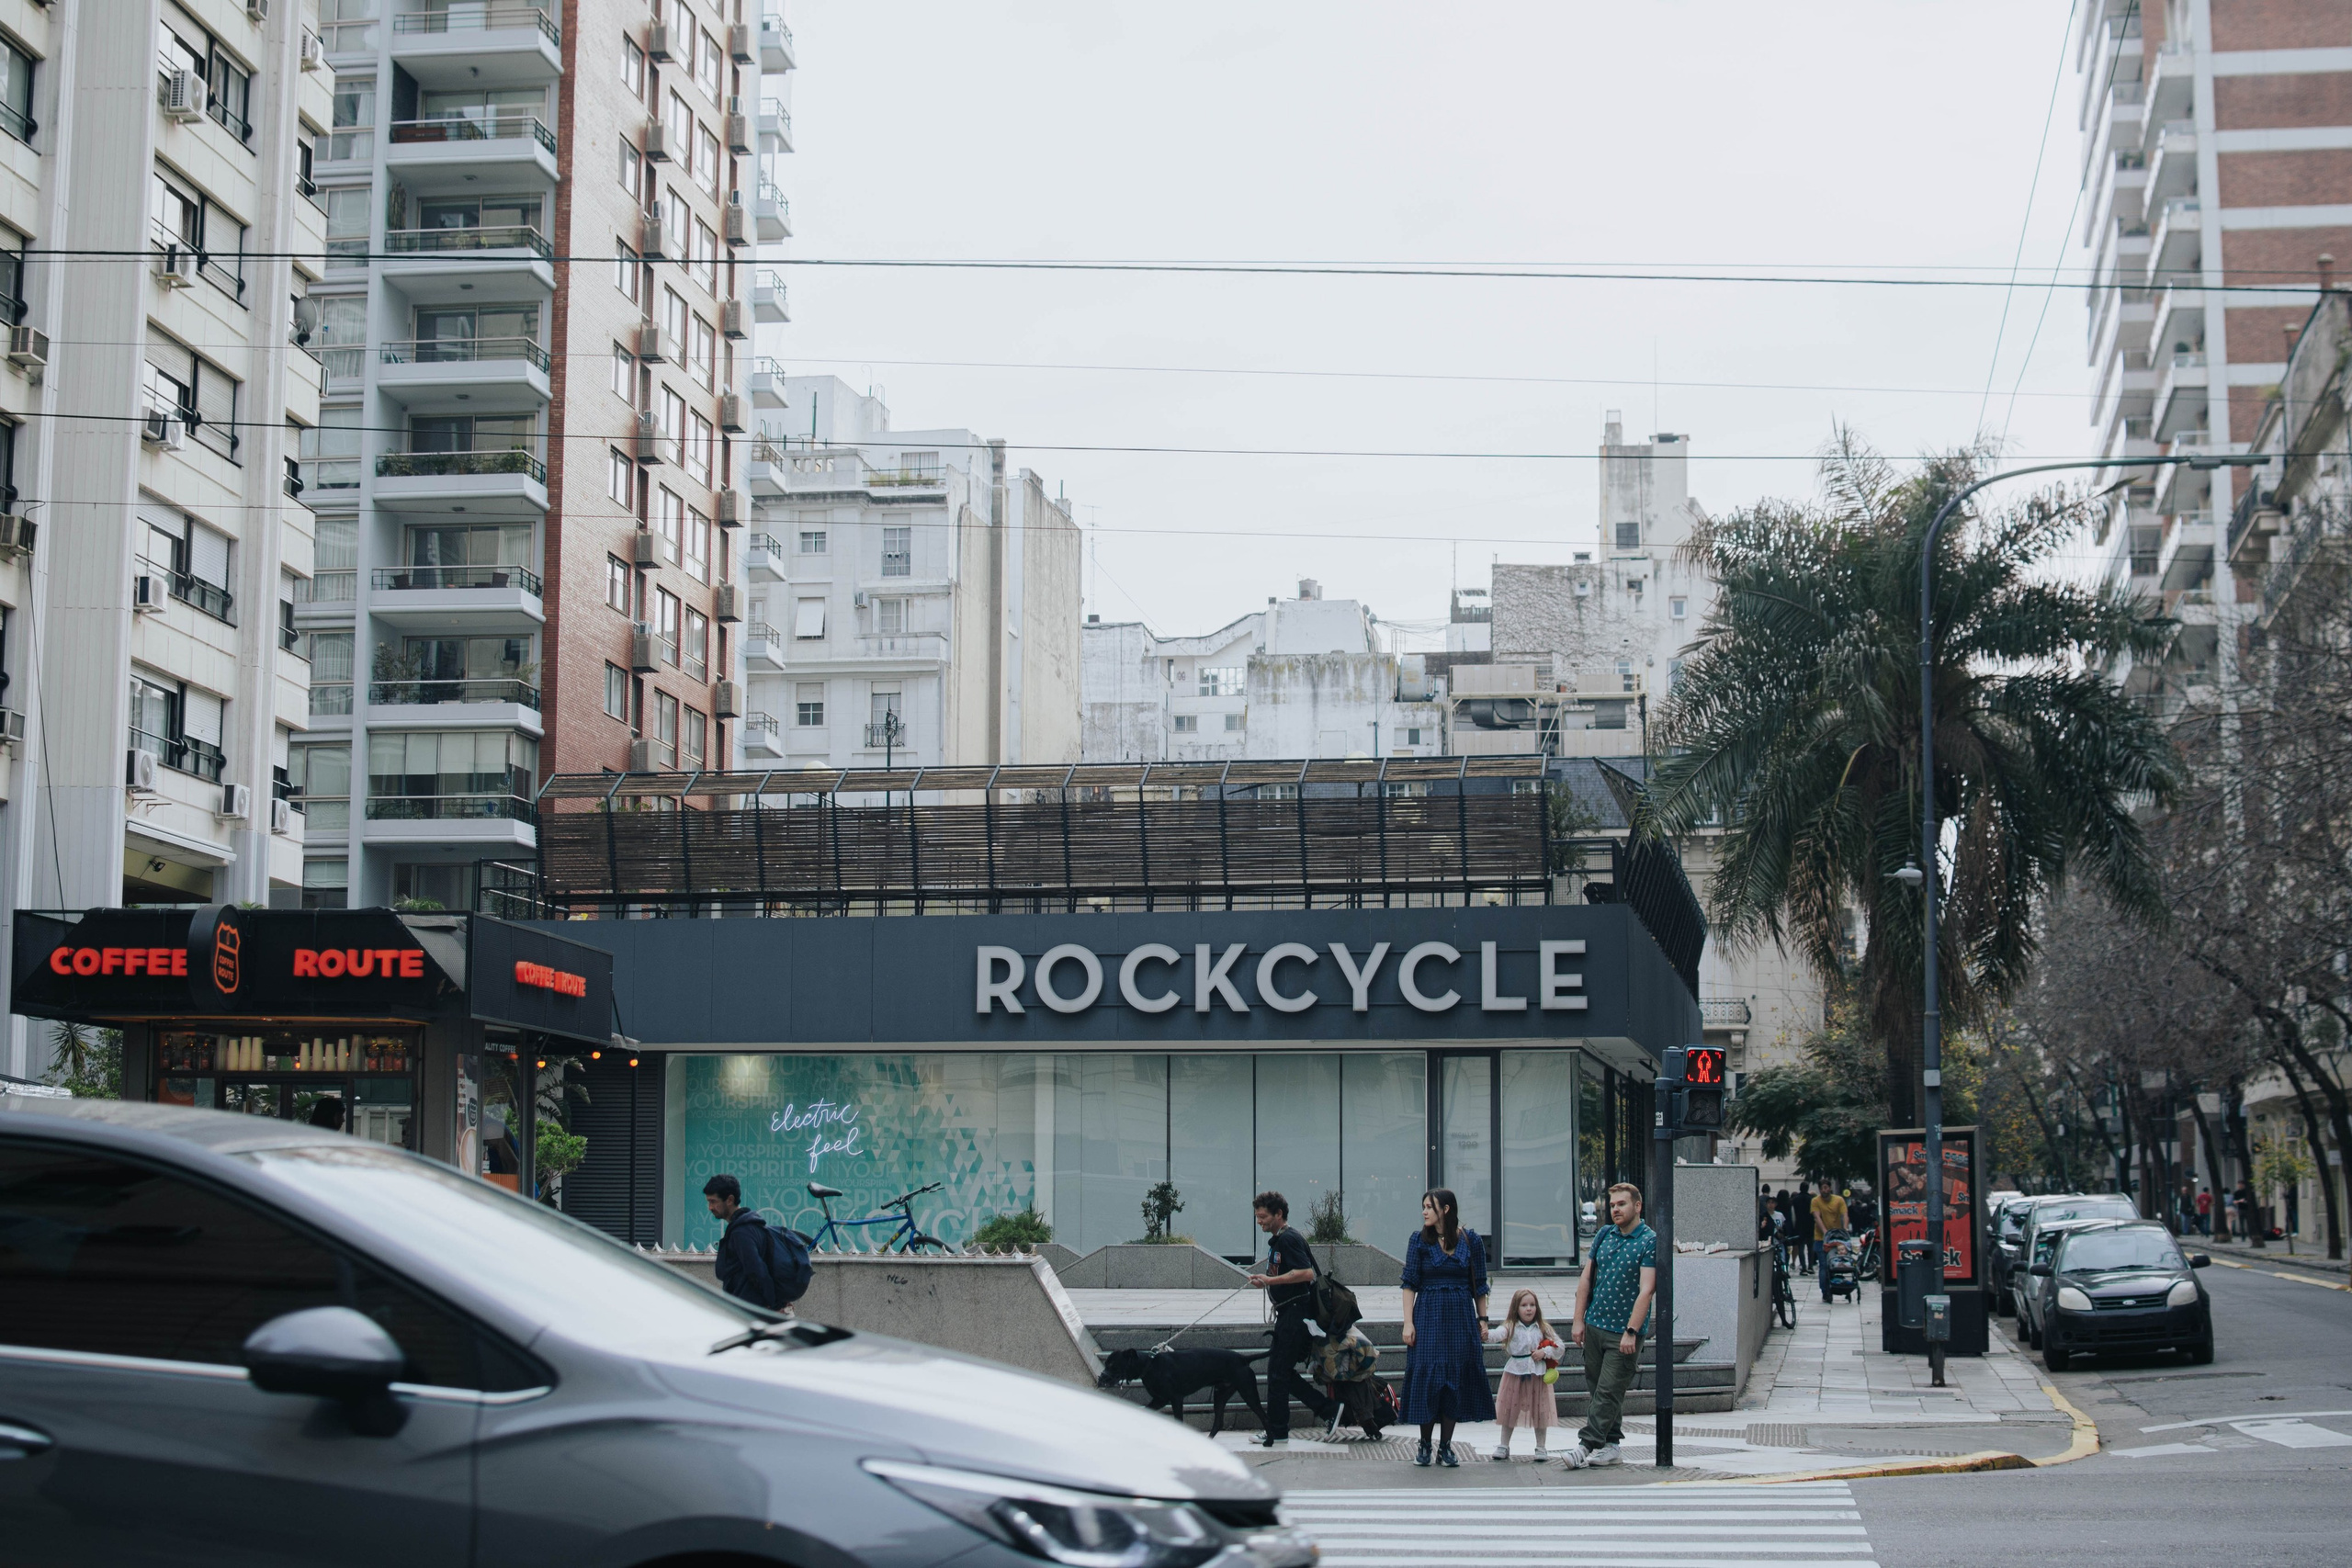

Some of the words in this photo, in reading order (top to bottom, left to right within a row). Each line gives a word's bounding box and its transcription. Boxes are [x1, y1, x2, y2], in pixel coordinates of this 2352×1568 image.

[50, 947, 187, 976] COFFEE
[293, 949, 424, 977] ROUTE
[219, 955, 234, 969] COFFEE
[218, 966, 234, 982] ROUTE
[516, 962, 554, 987] COFFEE
[554, 972, 587, 997] ROUTE
[977, 940, 1588, 1013] ROCKCYCLE
[499, 1043, 516, 1054] COFFEE
